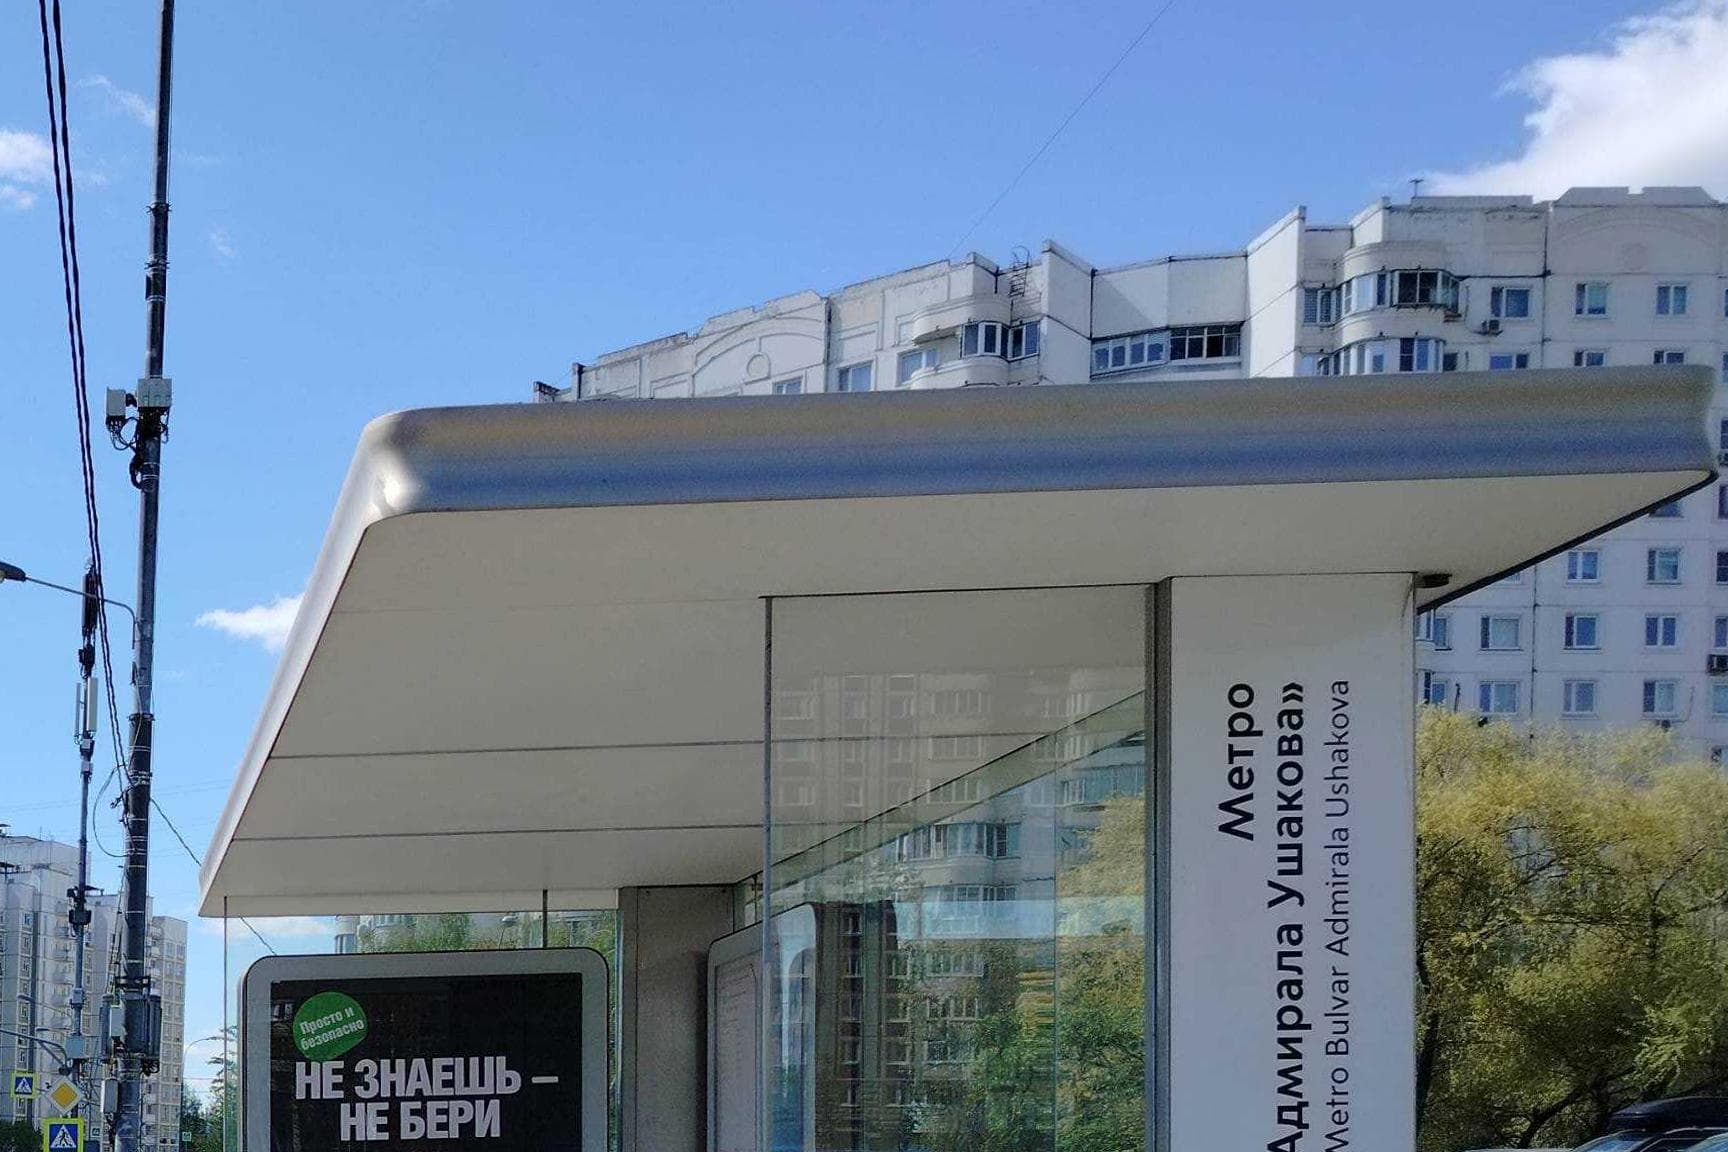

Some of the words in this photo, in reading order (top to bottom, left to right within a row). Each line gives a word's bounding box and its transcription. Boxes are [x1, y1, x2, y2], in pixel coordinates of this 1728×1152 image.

[1217, 683, 1264, 842] Метро
[1323, 680, 1350, 818] Ushakova
[1266, 681, 1306, 909] Ушакова»
[1323, 827, 1350, 957] Admirala
[301, 1012, 343, 1034] Просто
[345, 1007, 354, 1018] и
[301, 1020, 364, 1051] безопасно
[1324, 965, 1350, 1056] Bulvar
[295, 1060, 344, 1100] НЕ
[354, 1056, 522, 1099] ЗНАЕШЬ
[340, 1101, 389, 1141] НЕ
[400, 1099, 501, 1140] БЕРИ
